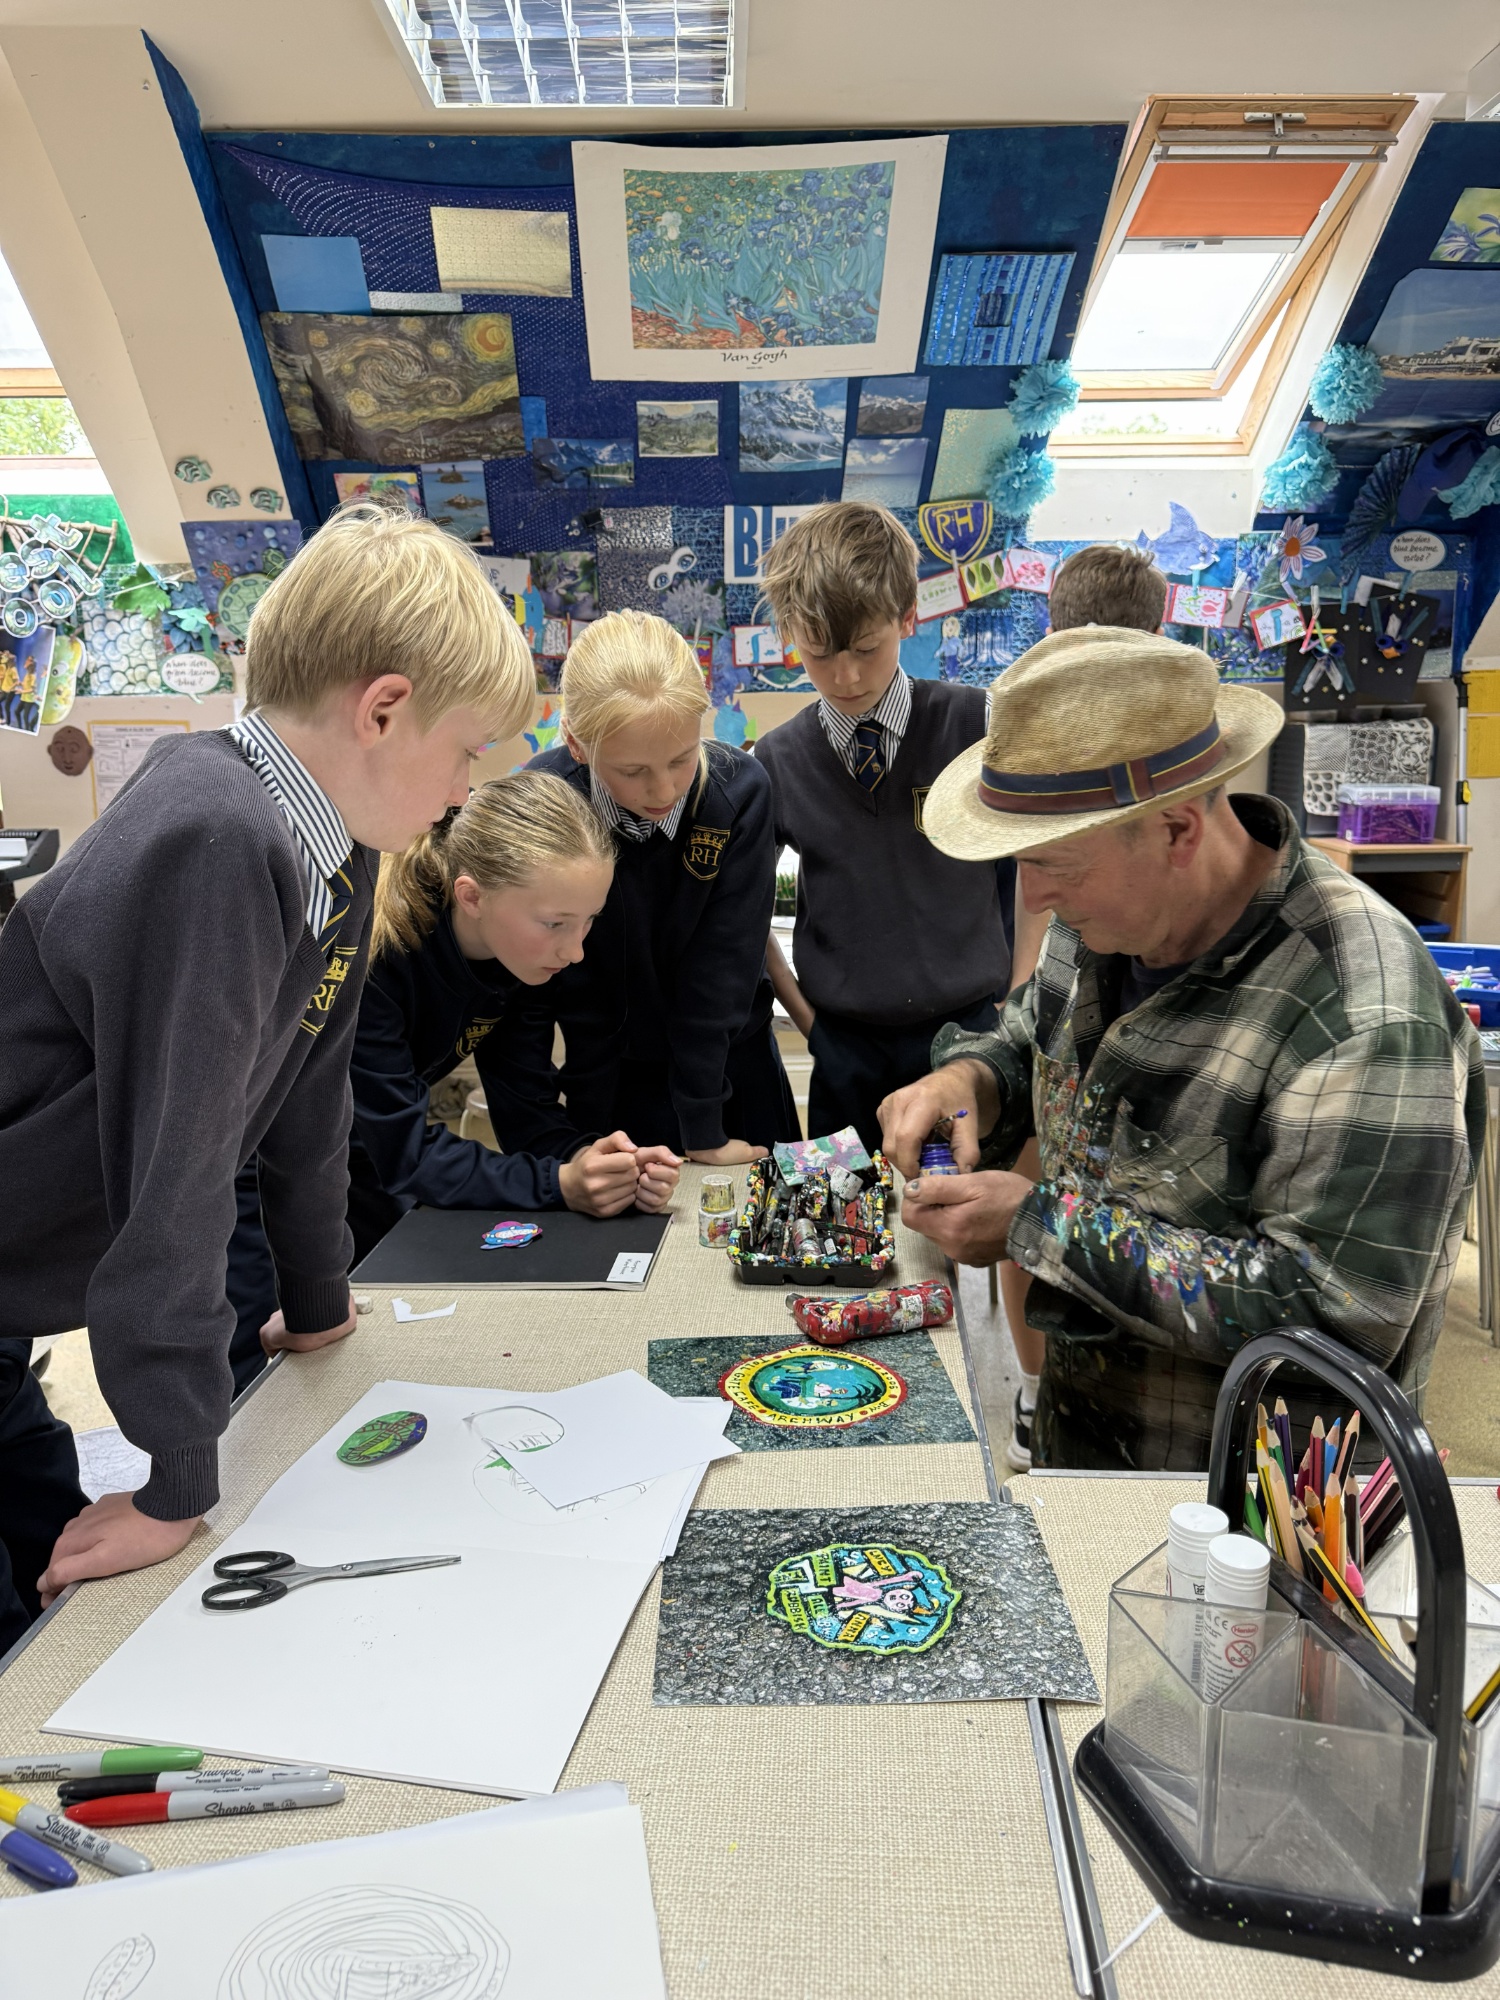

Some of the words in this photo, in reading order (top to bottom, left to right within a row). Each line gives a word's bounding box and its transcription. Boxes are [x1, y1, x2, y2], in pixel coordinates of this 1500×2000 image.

[720, 352, 749, 362] Van
[751, 349, 788, 365] Gogh
[733, 505, 799, 577] Bl
[690, 845, 720, 867] RH
[788, 1346, 848, 1357] LONDON
[768, 1412, 856, 1425] ARCHWAY
[1233, 1625, 1257, 1634] Henkel
